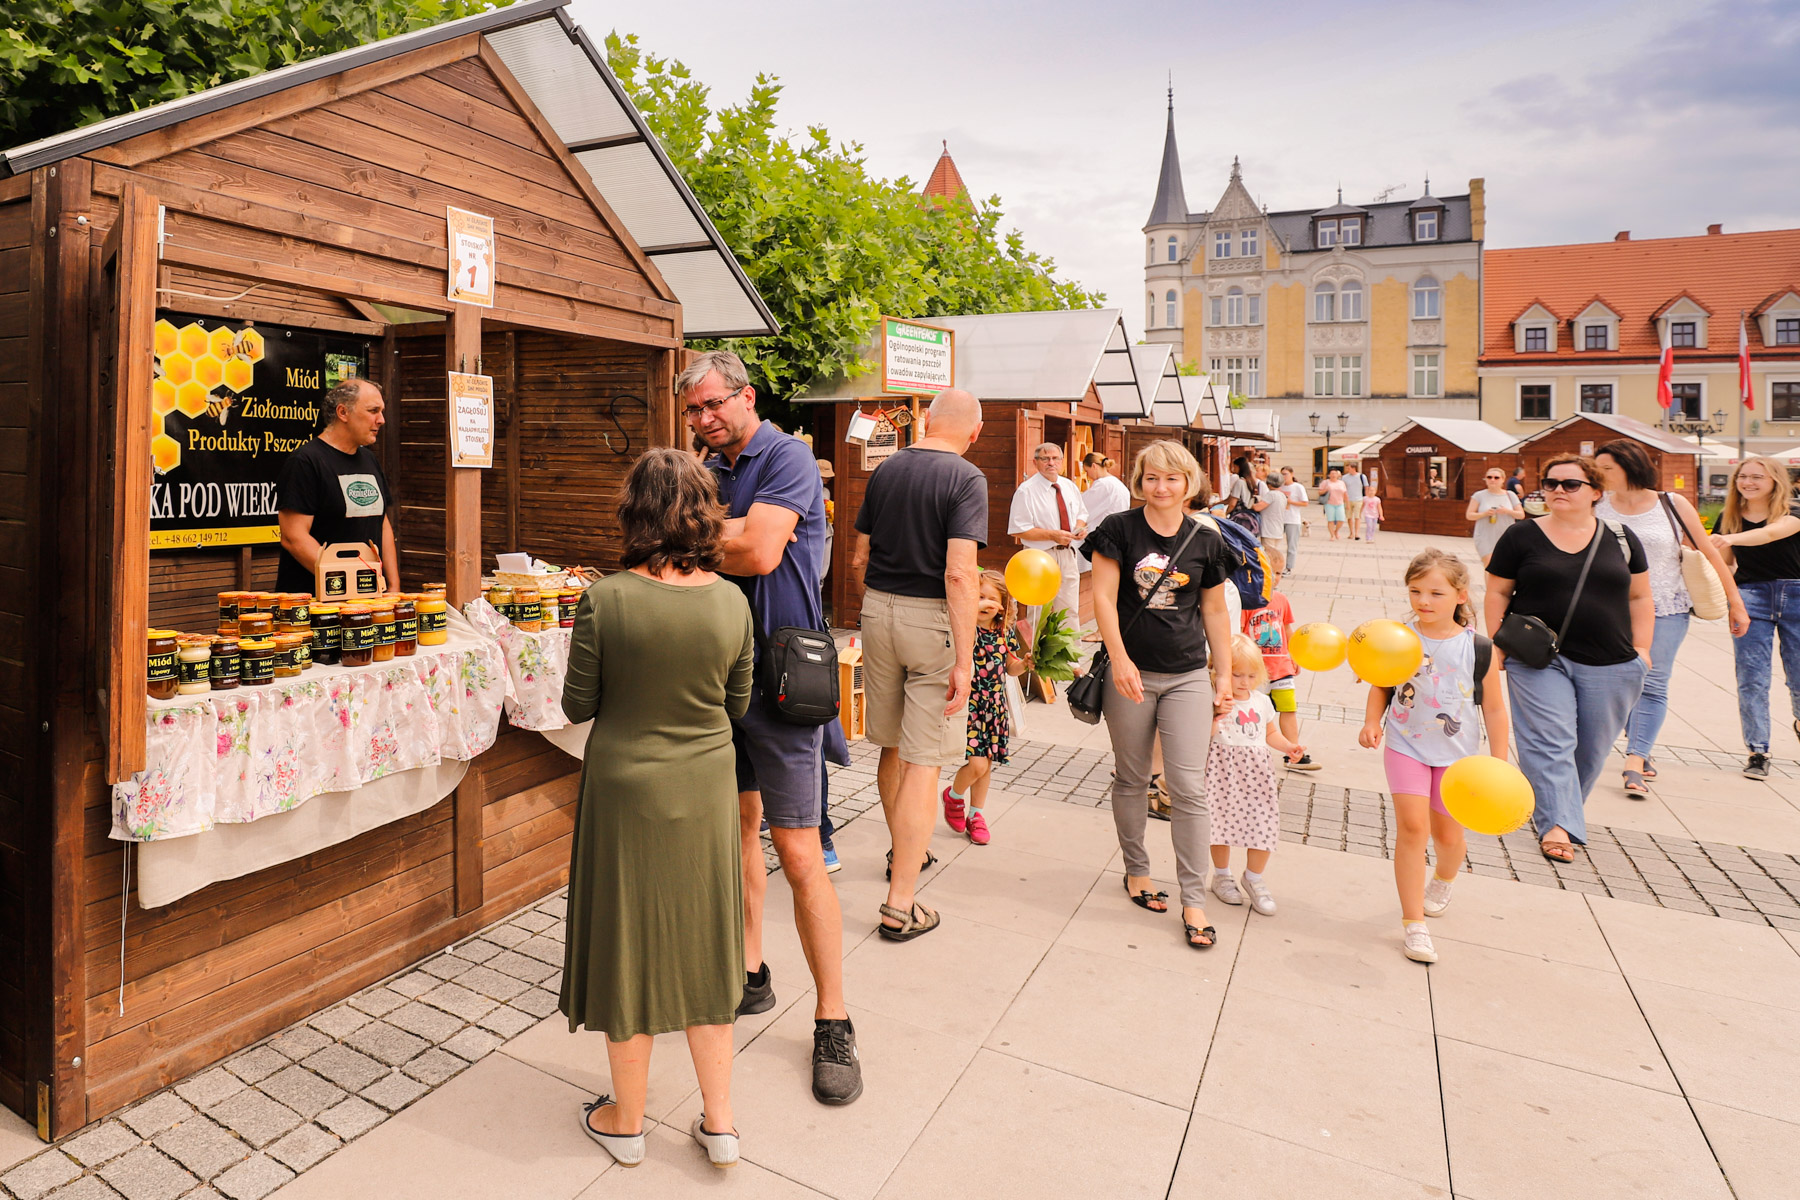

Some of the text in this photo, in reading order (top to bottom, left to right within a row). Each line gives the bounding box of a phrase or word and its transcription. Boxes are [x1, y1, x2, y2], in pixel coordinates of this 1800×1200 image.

[461, 239, 483, 250] STOISKO
[468, 265, 477, 288] 1
[896, 322, 938, 341] GREENPEACE
[889, 340, 946, 358] Ogólnopolski program
[894, 355, 941, 368] ratowania pszczół
[286, 366, 320, 390] Miód
[891, 368, 913, 377] owadów
[241, 396, 320, 428] Ziołomiody
[458, 406, 487, 416] ZAGŁOSUJ
[188, 428, 312, 458] Produkty Pszcz
[179, 482, 221, 518] POD
[150, 532, 228, 545] el. +48 662 149 712
[149, 656, 172, 668] Miód
[194, 662, 209, 670] Miód
